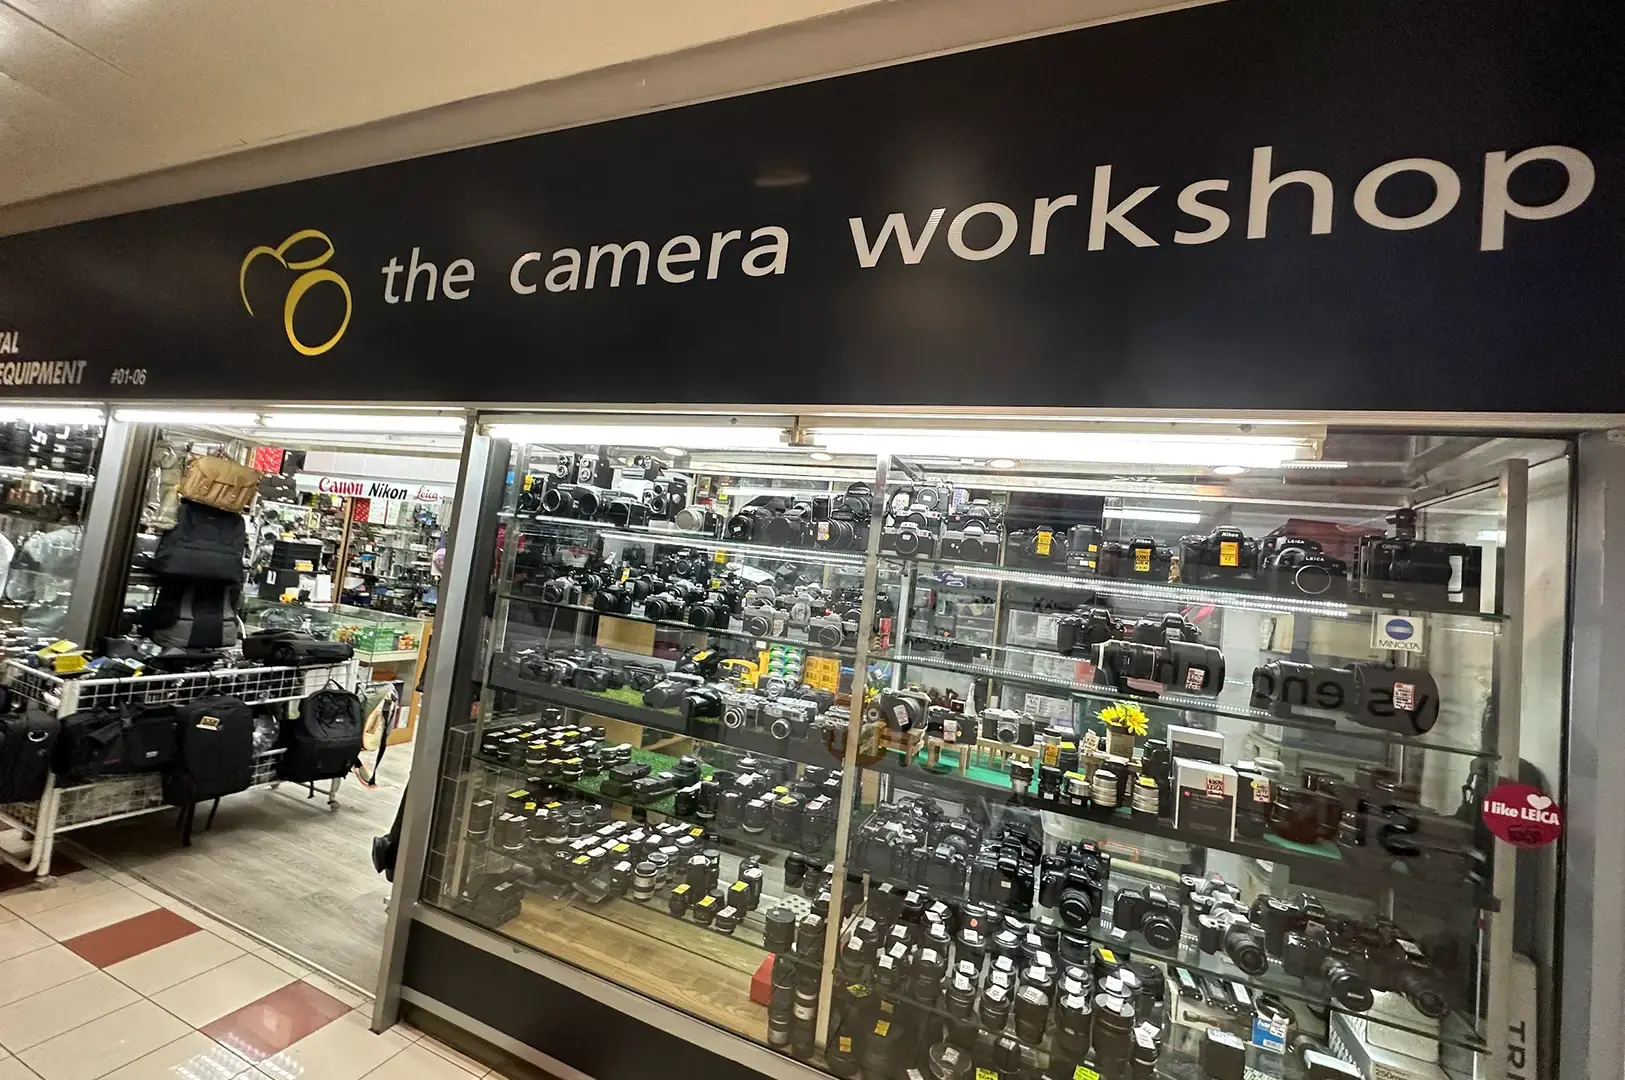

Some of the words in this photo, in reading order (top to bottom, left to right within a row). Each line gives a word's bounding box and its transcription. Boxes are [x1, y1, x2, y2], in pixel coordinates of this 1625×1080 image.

[381, 247, 475, 304] the
[509, 225, 790, 295] camera
[848, 144, 1596, 269] workshop
[110, 368, 147, 385] #01-06
[318, 477, 363, 495] Canon
[368, 483, 408, 500] Nikon
[1378, 639, 1420, 651] MINOLTA
[1483, 800, 1490, 813] I
[1491, 801, 1519, 818] like
[1520, 806, 1560, 826] LEICA
